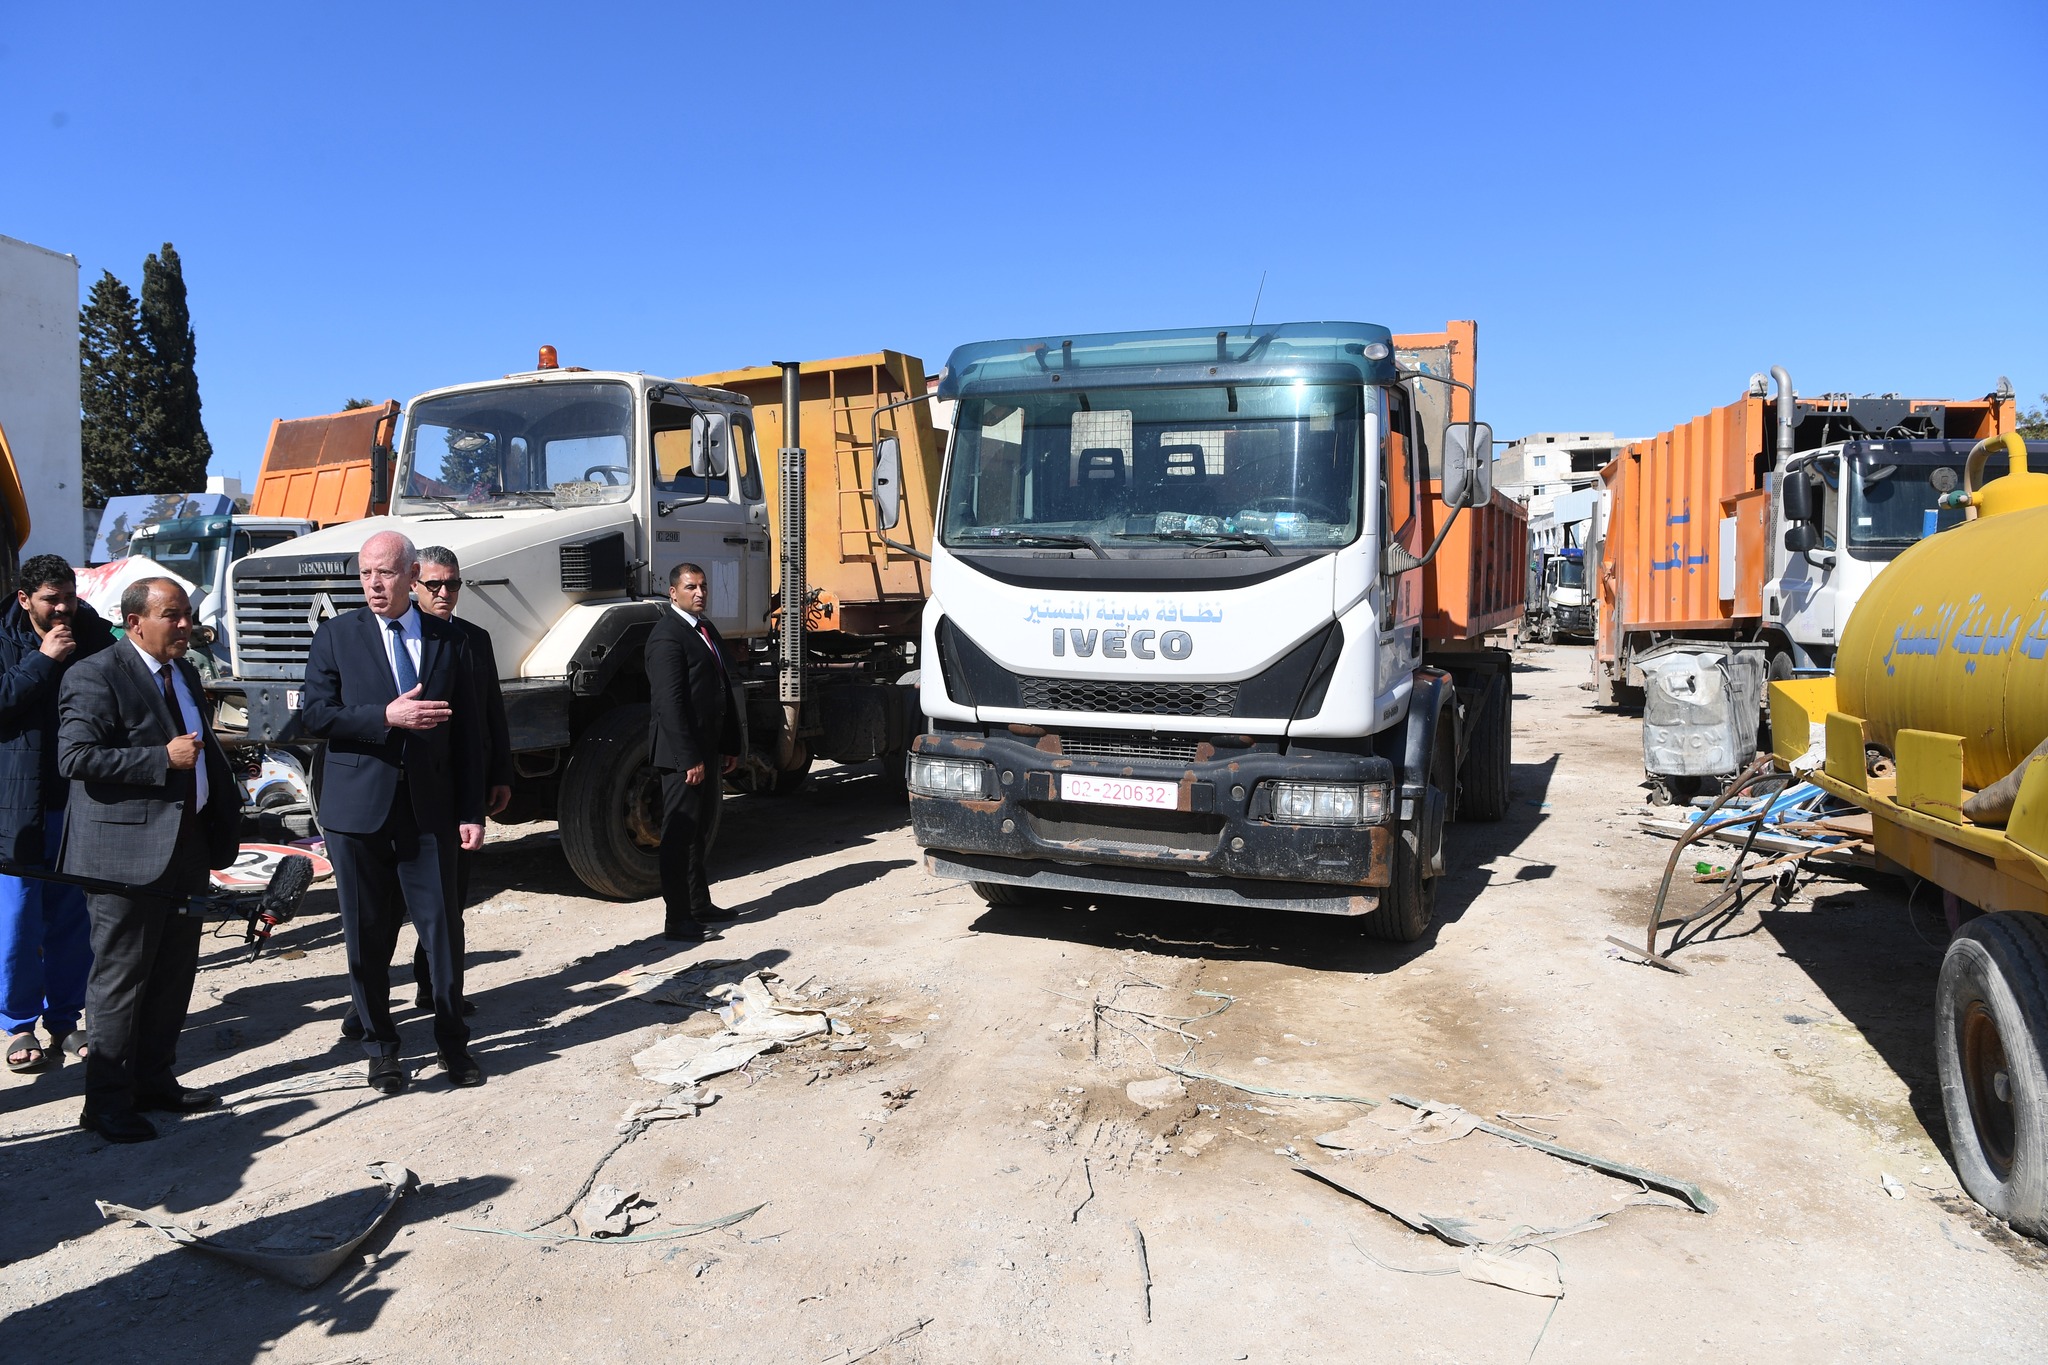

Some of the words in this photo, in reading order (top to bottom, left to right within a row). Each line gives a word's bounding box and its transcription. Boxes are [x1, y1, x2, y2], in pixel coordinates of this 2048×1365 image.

[298, 561, 345, 575] RENAULT
[1023, 599, 1090, 625] المنستير
[1096, 598, 1150, 627] مدينة
[1156, 600, 1223, 623] نظافة
[1052, 628, 1193, 660] IVECO
[1071, 780, 1165, 804] 02-220632
